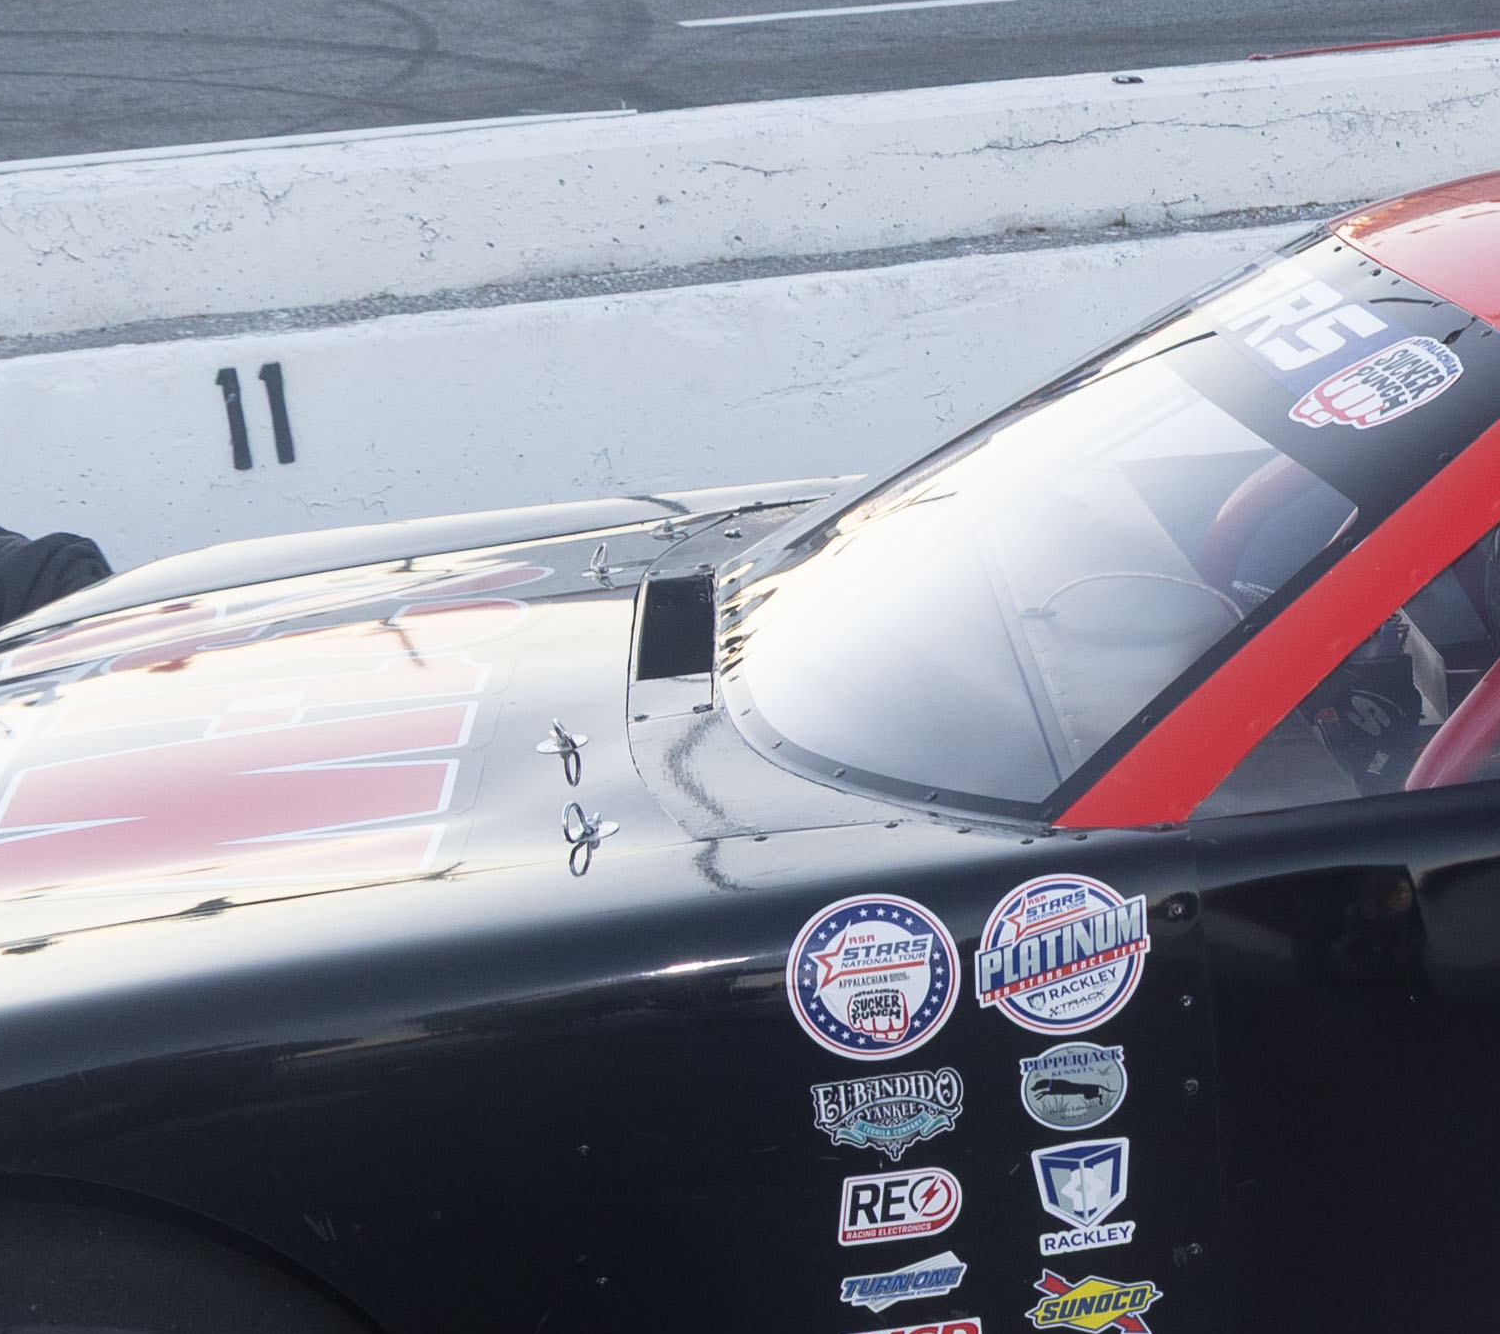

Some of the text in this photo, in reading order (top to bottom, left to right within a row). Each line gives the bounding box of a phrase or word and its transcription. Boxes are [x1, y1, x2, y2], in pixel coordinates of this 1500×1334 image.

[1374, 348, 1446, 402] SUCKER
[1343, 364, 1408, 416] PUNCH
[215, 362, 295, 470] 11
[1026, 889, 1086, 917] STARS
[843, 938, 928, 961] STARS
[981, 899, 1142, 993] PLATINUM
[841, 951, 926, 969] NATIONAL TOUR
[838, 974, 888, 989] APPALACHIAN
[1049, 966, 1117, 1001] RACKLEY
[851, 1009, 902, 1025] PUNCH
[852, 995, 902, 1013] SUCKER
[1022, 1047, 1123, 1073] PEPPERJACK
[864, 1102, 918, 1120] YANKEE
[863, 1117, 924, 1137] TEQUILA COMPANY
[846, 1221, 932, 1240] RACING ELECTRONICS
[1044, 1225, 1131, 1251] RACKLEY
[1040, 1287, 1147, 1323] SUNOCO
